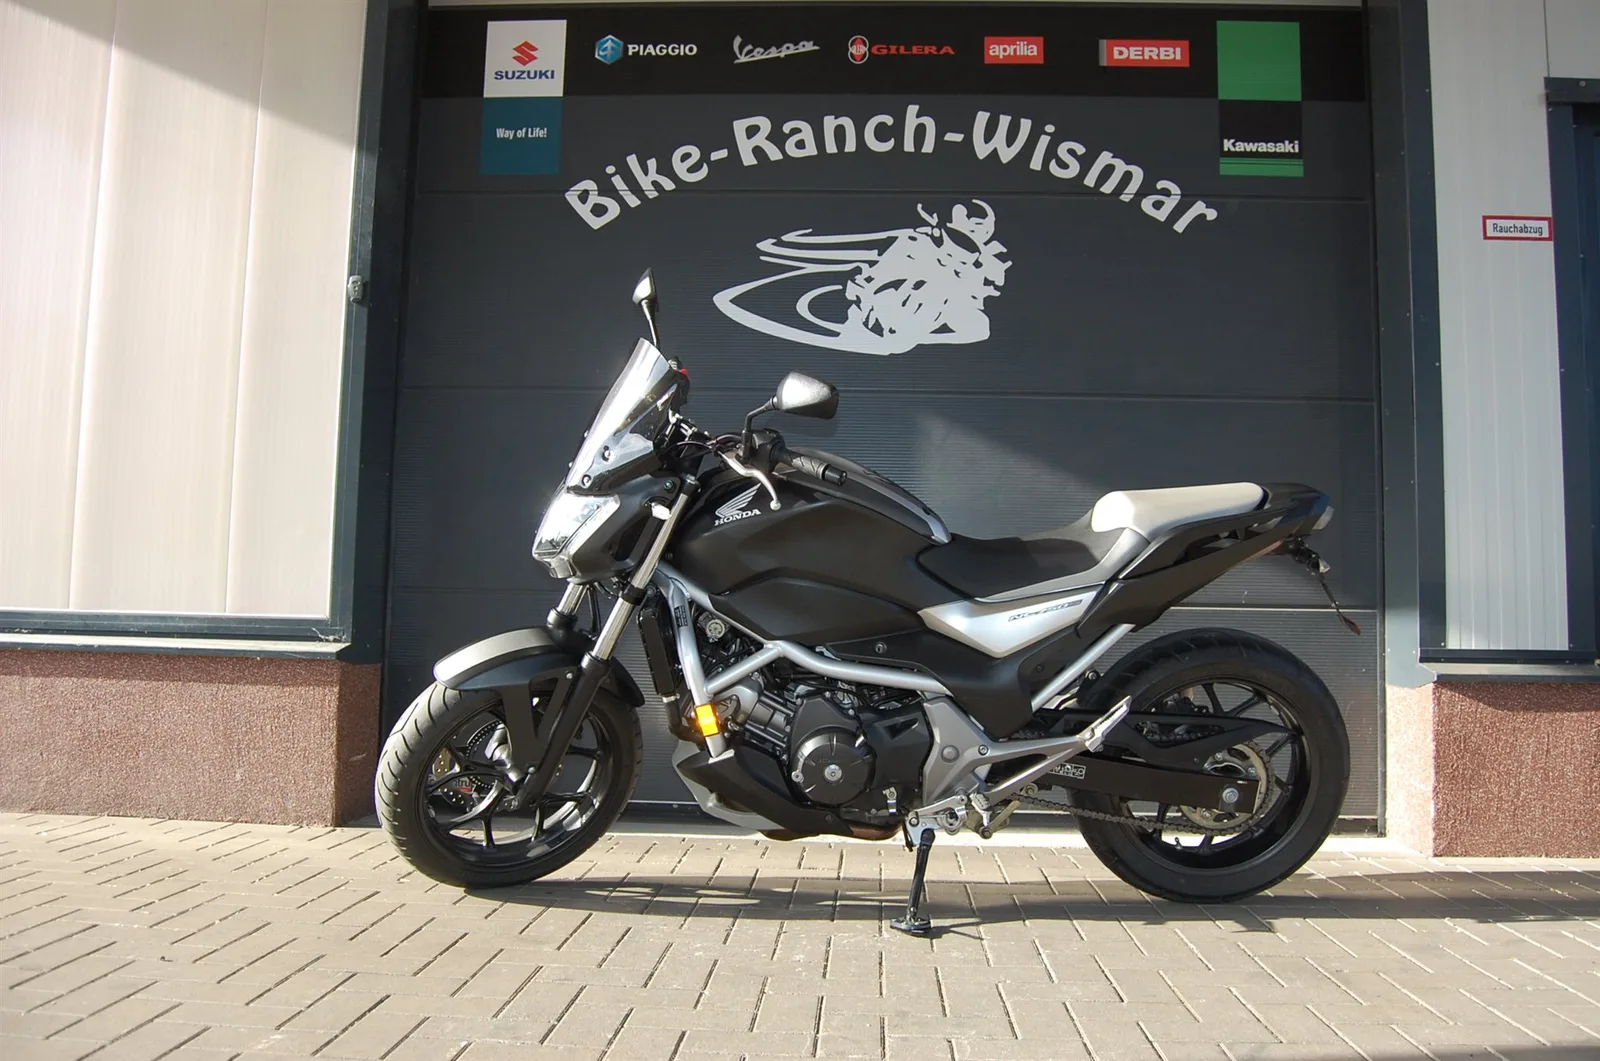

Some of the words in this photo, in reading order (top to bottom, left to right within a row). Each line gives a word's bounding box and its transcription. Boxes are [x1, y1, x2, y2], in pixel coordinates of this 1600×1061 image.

[627, 43, 698, 57] PIAGGIO
[733, 35, 820, 64] Vespa
[871, 44, 955, 55] GILERA
[989, 41, 1038, 58] aprilia
[1113, 46, 1182, 61] DERBI
[494, 69, 555, 81] SUZUKI
[496, 128, 515, 141] Way
[516, 127, 527, 139] of
[528, 127, 548, 139] Life!
[1223, 138, 1300, 154] Kawasaki
[564, 104, 1218, 234] Bike-Ranch-Wismar
[1493, 222, 1543, 237] Rauchabzug
[714, 508, 762, 527] HONDA
